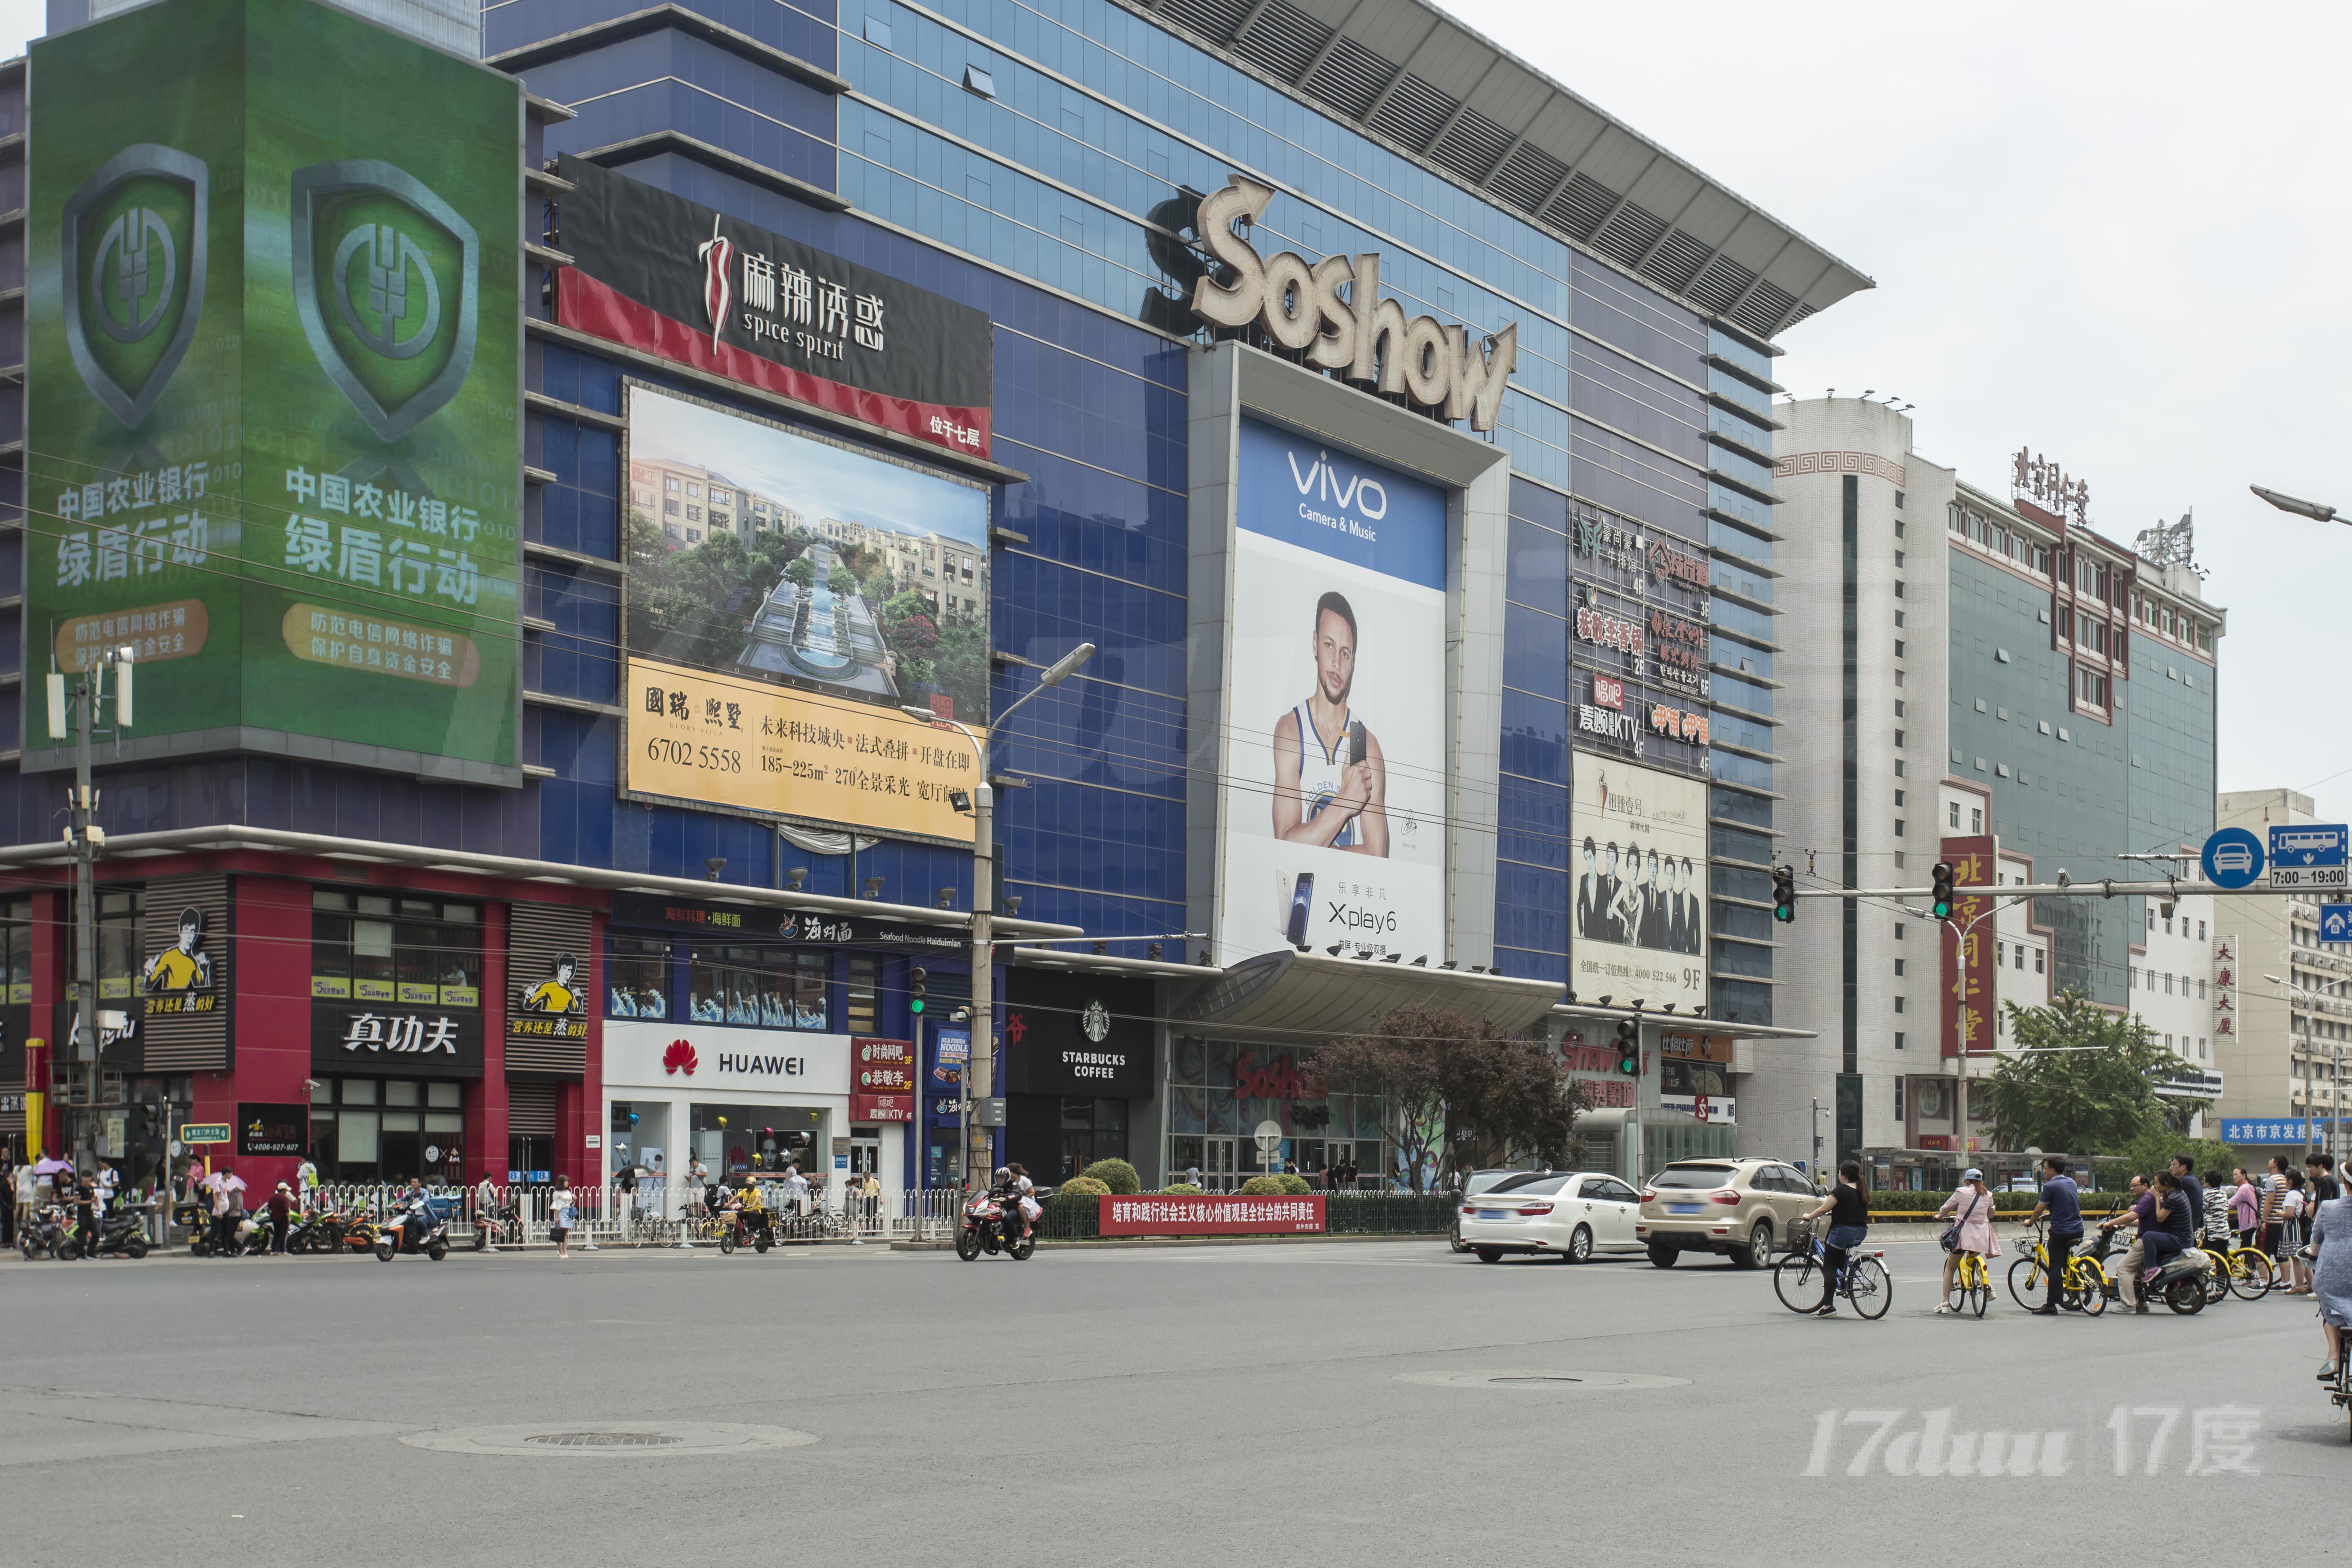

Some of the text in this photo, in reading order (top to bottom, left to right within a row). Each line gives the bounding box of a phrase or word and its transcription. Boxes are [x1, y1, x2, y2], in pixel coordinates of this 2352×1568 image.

[742, 252, 884, 352] 麻辣诱惑
[1190, 173, 1517, 432] Soshow
[743, 312, 844, 361] spice spirit
[929, 415, 980, 448] 位于七层
[58, 461, 209, 523] 中国农业银行
[1288, 450, 1387, 521] vivo
[286, 466, 479, 542] 中国农业银行
[1299, 503, 1376, 542] Camera & Music
[57, 509, 207, 587] 绿盾行动
[285, 513, 478, 605] 绿盾行动
[1608, 548, 1636, 573] 牛排馆
[75, 607, 185, 643] 防范电信网络诈骗
[310, 611, 453, 657] 防范电信网络诈骗
[310, 636, 452, 681] 保护自身资金安全
[669, 722, 723, 737] GLORY VILLA
[760, 715, 970, 772] 未来科技城央 法式叠拼 开盘在即
[648, 737, 741, 774] 6702 5558
[1305, 781, 1333, 805] GOLDEN
[1630, 820, 1650, 834] 麻辣火锅
[1339, 882, 1387, 900] 乐享非凡
[1328, 901, 1396, 934] Xplay6
[880, 931, 961, 948] Seafood Noodle Haiduimian
[1952, 852, 1983, 1042] 北京同仁堂
[1635, 968, 1650, 981] 4000
[1652, 970, 1664, 982] 522
[1665, 971, 1677, 984] 566
[1683, 967, 1701, 991] 9F
[2216, 943, 2234, 1035] 大康大厦
[146, 991, 214, 1013] 营养还是蒸的好
[343, 1013, 459, 1054] 真功夫
[512, 1017, 588, 1038] 营养还是蒸的好
[873, 1043, 904, 1060] 时尚网吧
[940, 1043, 969, 1052] NOODLE
[1062, 1051, 1125, 1066] STARBUCKS
[1662, 1033, 1694, 1056] 比格比萨
[719, 1053, 804, 1076] HUAWEI
[904, 1056, 913, 1065] 3F
[1074, 1066, 1114, 1079] COFFEE
[872, 1069, 904, 1086] 恭敬李
[904, 1081, 913, 1090] 2F
[1112, 1201, 1314, 1223] 培育和践行社会主义核心价值观是全社会的共同责任
